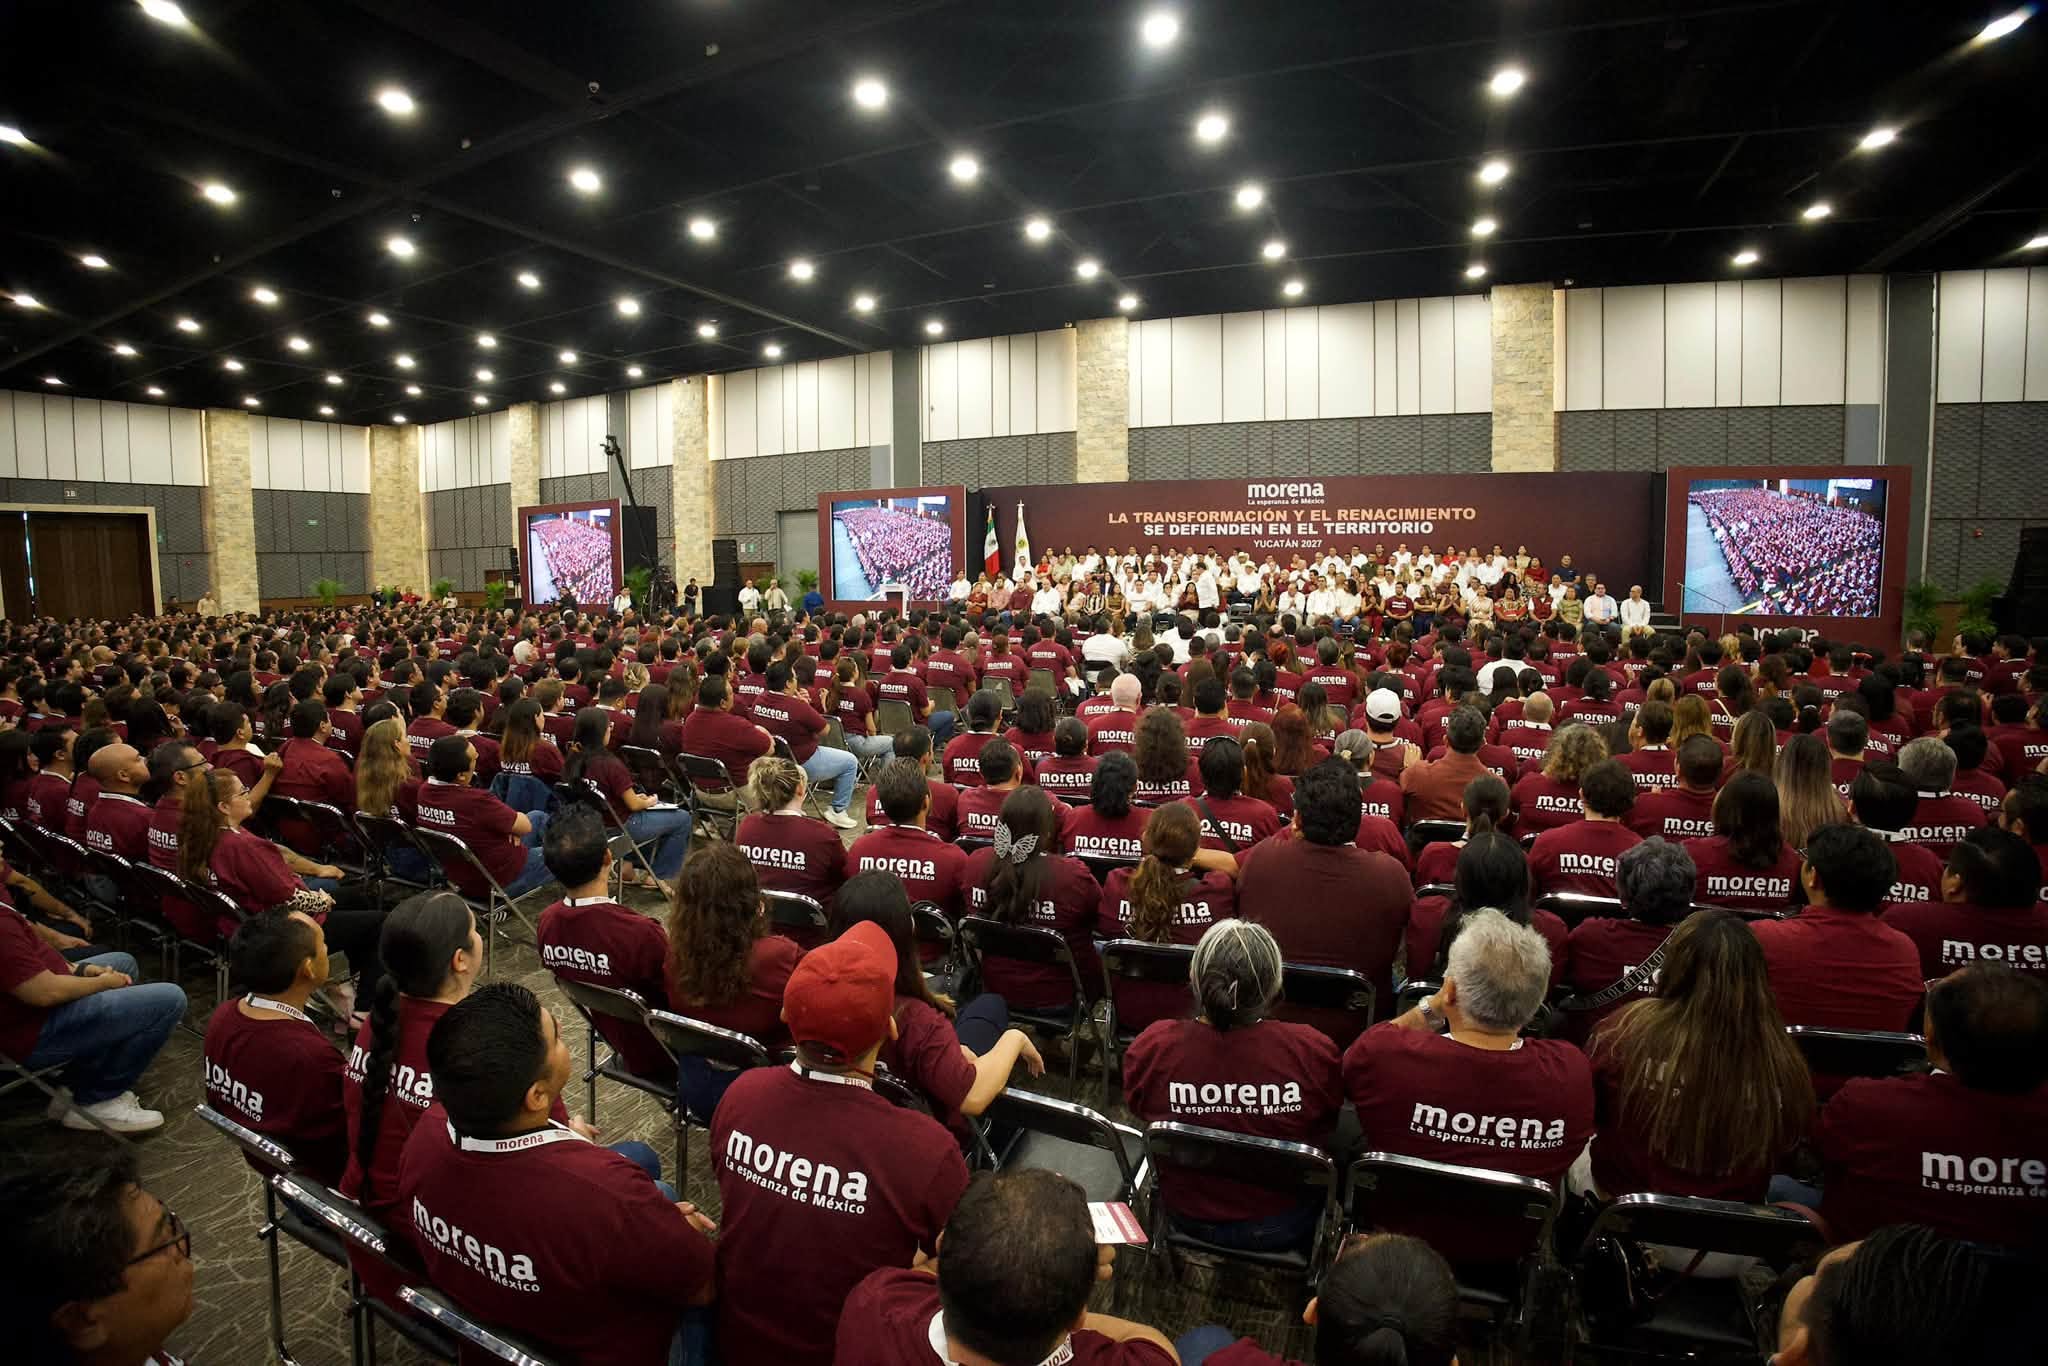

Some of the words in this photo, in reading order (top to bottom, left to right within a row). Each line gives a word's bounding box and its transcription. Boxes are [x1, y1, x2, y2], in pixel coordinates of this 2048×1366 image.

[1248, 482, 1324, 498] morena
[1108, 513, 1128, 524] LA
[1133, 508, 1287, 523] TRANSFORMACIÓN
[1293, 510, 1304, 521] Y
[1310, 510, 1331, 521] EL
[1337, 508, 1476, 521] RENACIMIENTO
[1144, 524, 1164, 536] SE
[1169, 524, 1263, 535] DEFIENDEN
[1268, 523, 1291, 535] EN
[1297, 523, 1318, 534] EL
[1324, 522, 1433, 534] TERRITORIO
[1254, 539, 1299, 548] YUCATÁN
[1301, 540, 1322, 548] 2027
[880, 683, 908, 692] morena
[1312, 676, 1347, 684] morena
[754, 704, 789, 718] morena
[1098, 730, 1136, 741] moren
[953, 758, 980, 768] more
[1040, 773, 1093, 783] morena
[1537, 795, 1584, 809] more
[417, 804, 456, 821] morena
[968, 812, 998, 826] mor
[1664, 817, 1714, 832] more
[1899, 825, 1976, 840] moren
[1075, 835, 1142, 851] morena
[740, 844, 806, 865] morena
[860, 856, 935, 875] morena
[1560, 853, 1618, 873] more
[1707, 875, 1791, 893] morena
[1718, 890, 1755, 898] esperanza
[1758, 890, 1767, 898] de
[1184, 916, 1213, 925] México
[543, 943, 610, 970] morena
[1943, 939, 2048, 962] more
[397, 1087, 430, 1108] México
[1169, 1081, 1302, 1106] morena
[1171, 1103, 1182, 1114] La
[1185, 1104, 1242, 1115] esperanza
[1245, 1105, 1259, 1115] de
[1263, 1103, 1302, 1115] México
[1412, 1102, 1565, 1140] morena
[495, 1134, 544, 1150] morena
[1410, 1122, 1424, 1133] La
[1429, 1128, 1496, 1146] esperanza
[1500, 1137, 1516, 1148] de
[1520, 1139, 1564, 1149] México
[727, 1129, 868, 1202] morena
[1922, 1151, 2048, 1185] more
[725, 1156, 734, 1171] La
[737, 1164, 788, 1196] esperanza
[791, 1187, 808, 1202] de
[812, 1193, 865, 1215] México
[1922, 1177, 1940, 1190] La
[1946, 1182, 2025, 1196] esperanza
[413, 1195, 537, 1281] morena
[490, 1270, 541, 1292] México
